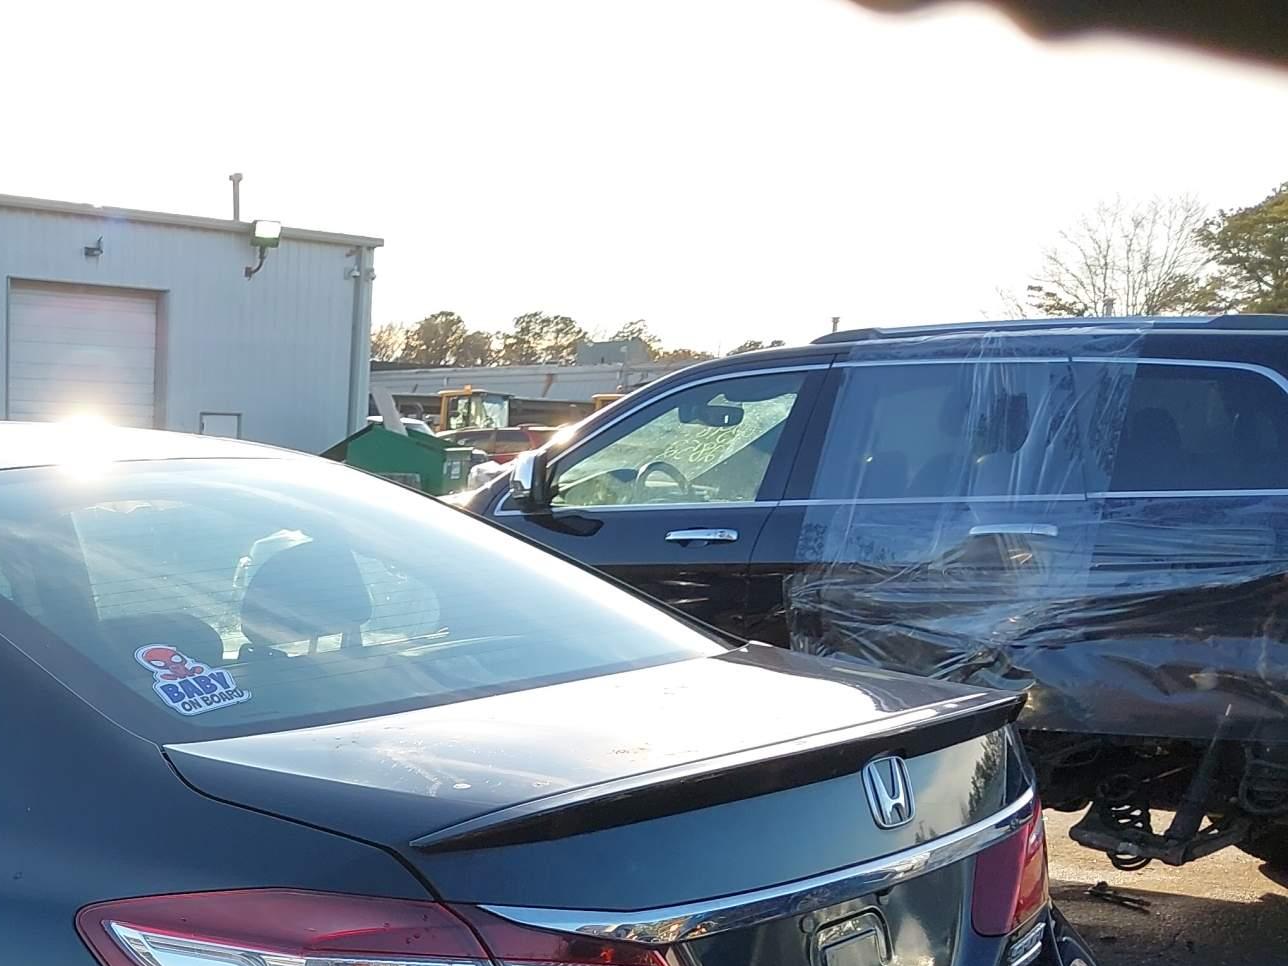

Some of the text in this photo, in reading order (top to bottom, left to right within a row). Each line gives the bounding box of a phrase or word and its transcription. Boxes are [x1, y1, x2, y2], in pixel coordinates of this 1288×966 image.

[160, 671, 230, 704] BABY
[181, 689, 244, 712] ON BOARD
